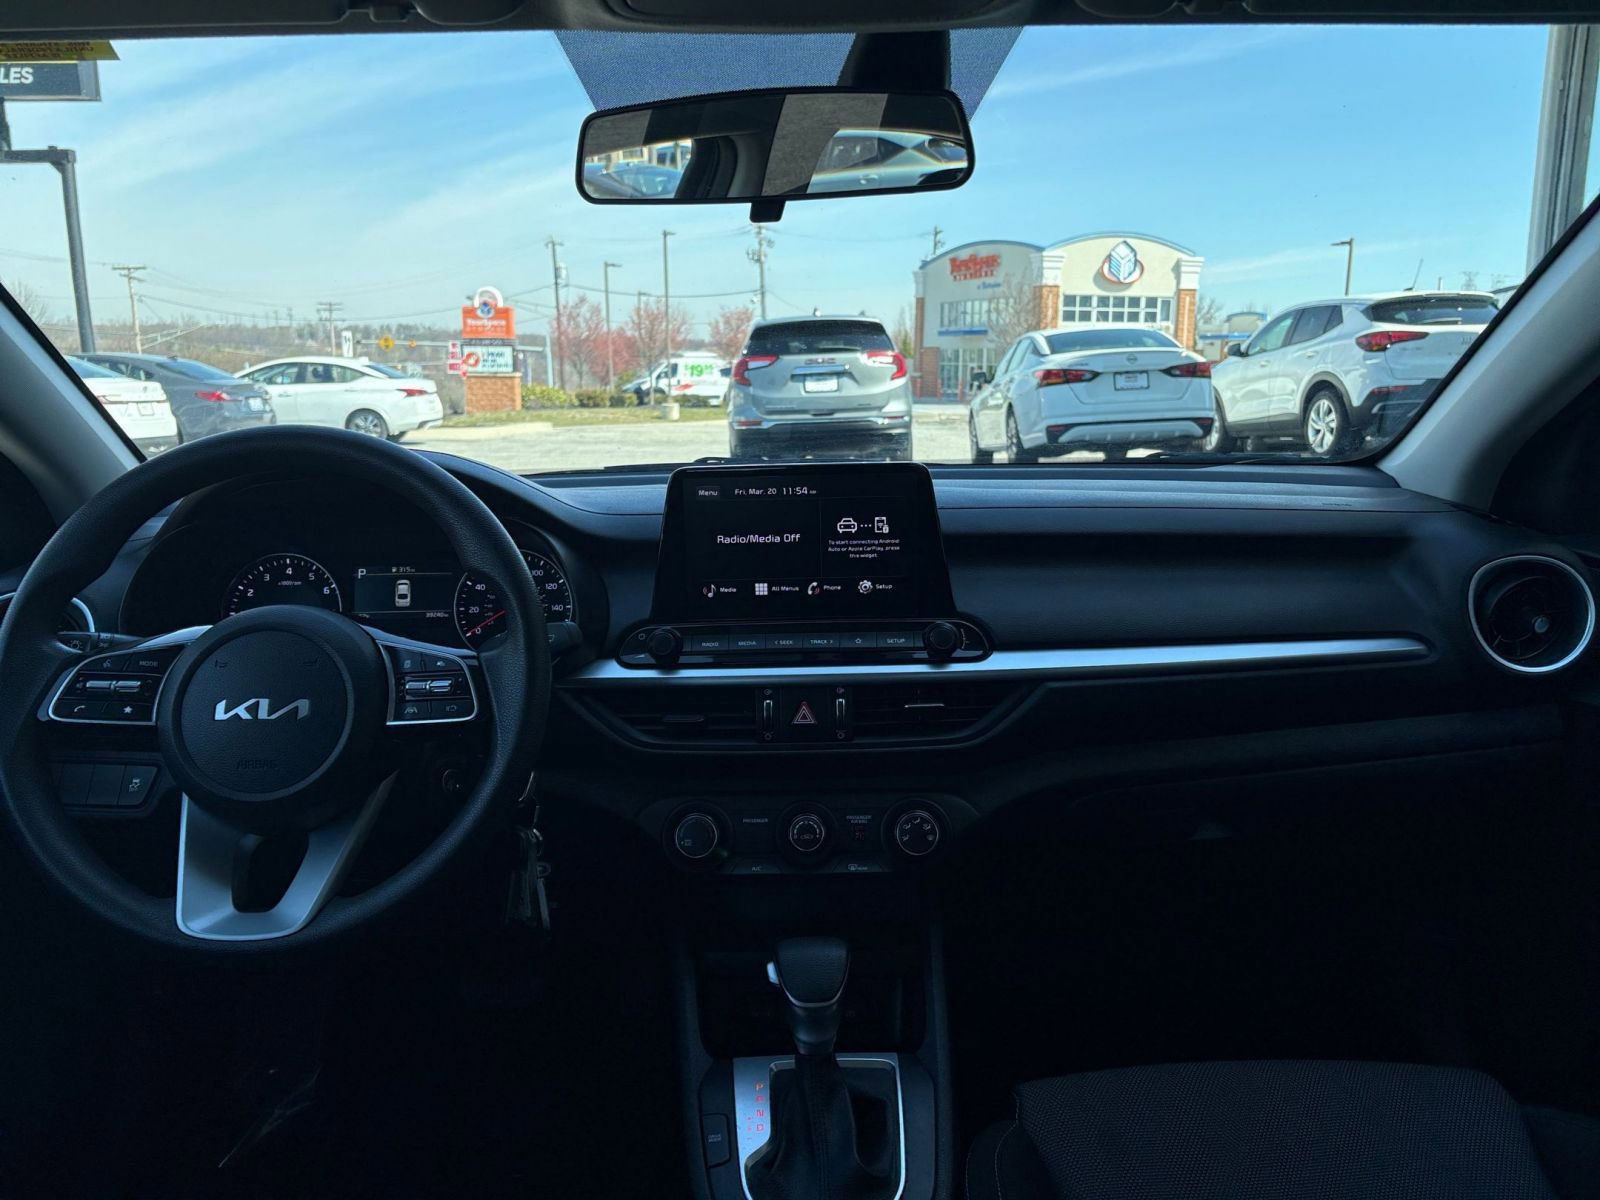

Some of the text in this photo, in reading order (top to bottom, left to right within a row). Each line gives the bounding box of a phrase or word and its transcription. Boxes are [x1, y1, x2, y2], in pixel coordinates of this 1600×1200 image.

[783, 486, 808, 495] 11:54
[717, 533, 801, 544] Radio/Media Off
[286, 567, 293, 575] 4
[357, 568, 367, 579] P
[531, 569, 544, 577] 100
[263, 573, 270, 581] 3
[308, 572, 315, 580] 5
[323, 586, 330, 594] 6
[475, 583, 486, 591] 40
[247, 589, 254, 597] 2
[213, 697, 310, 721] KIA
